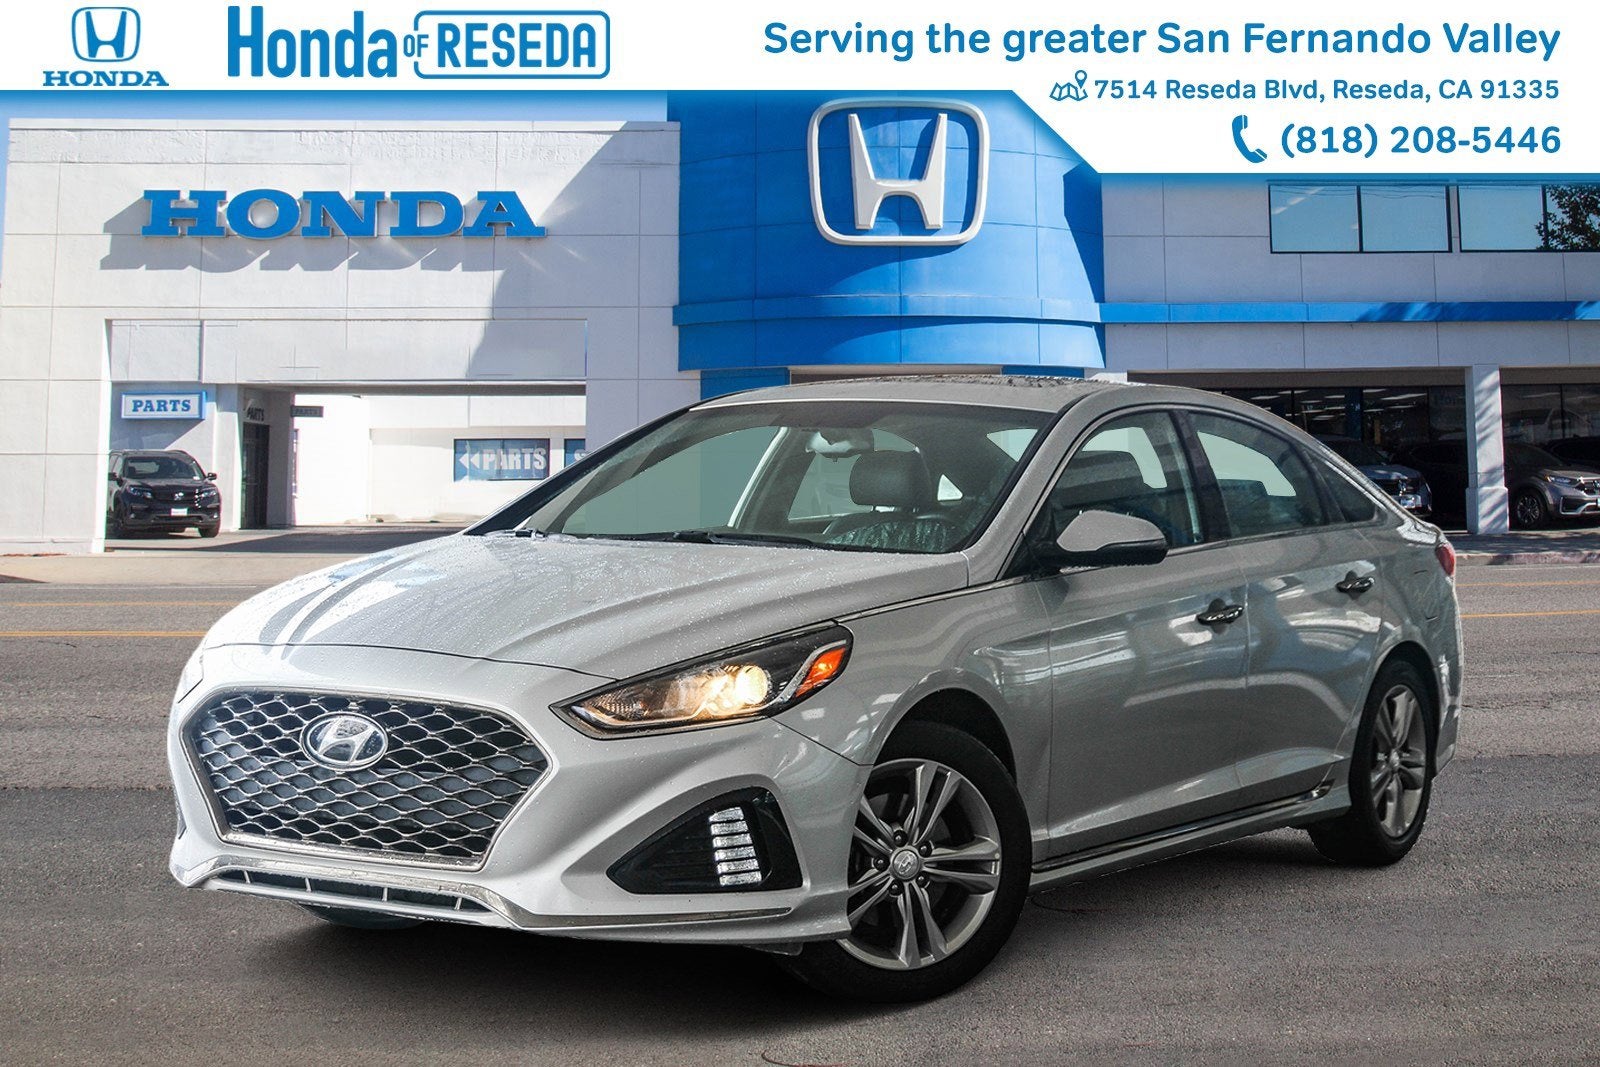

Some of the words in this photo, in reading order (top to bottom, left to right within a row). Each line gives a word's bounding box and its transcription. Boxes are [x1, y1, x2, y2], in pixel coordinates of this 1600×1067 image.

[141, 188, 548, 240] HONDA
[131, 399, 192, 413] PARTS
[482, 447, 547, 471] PARTS
